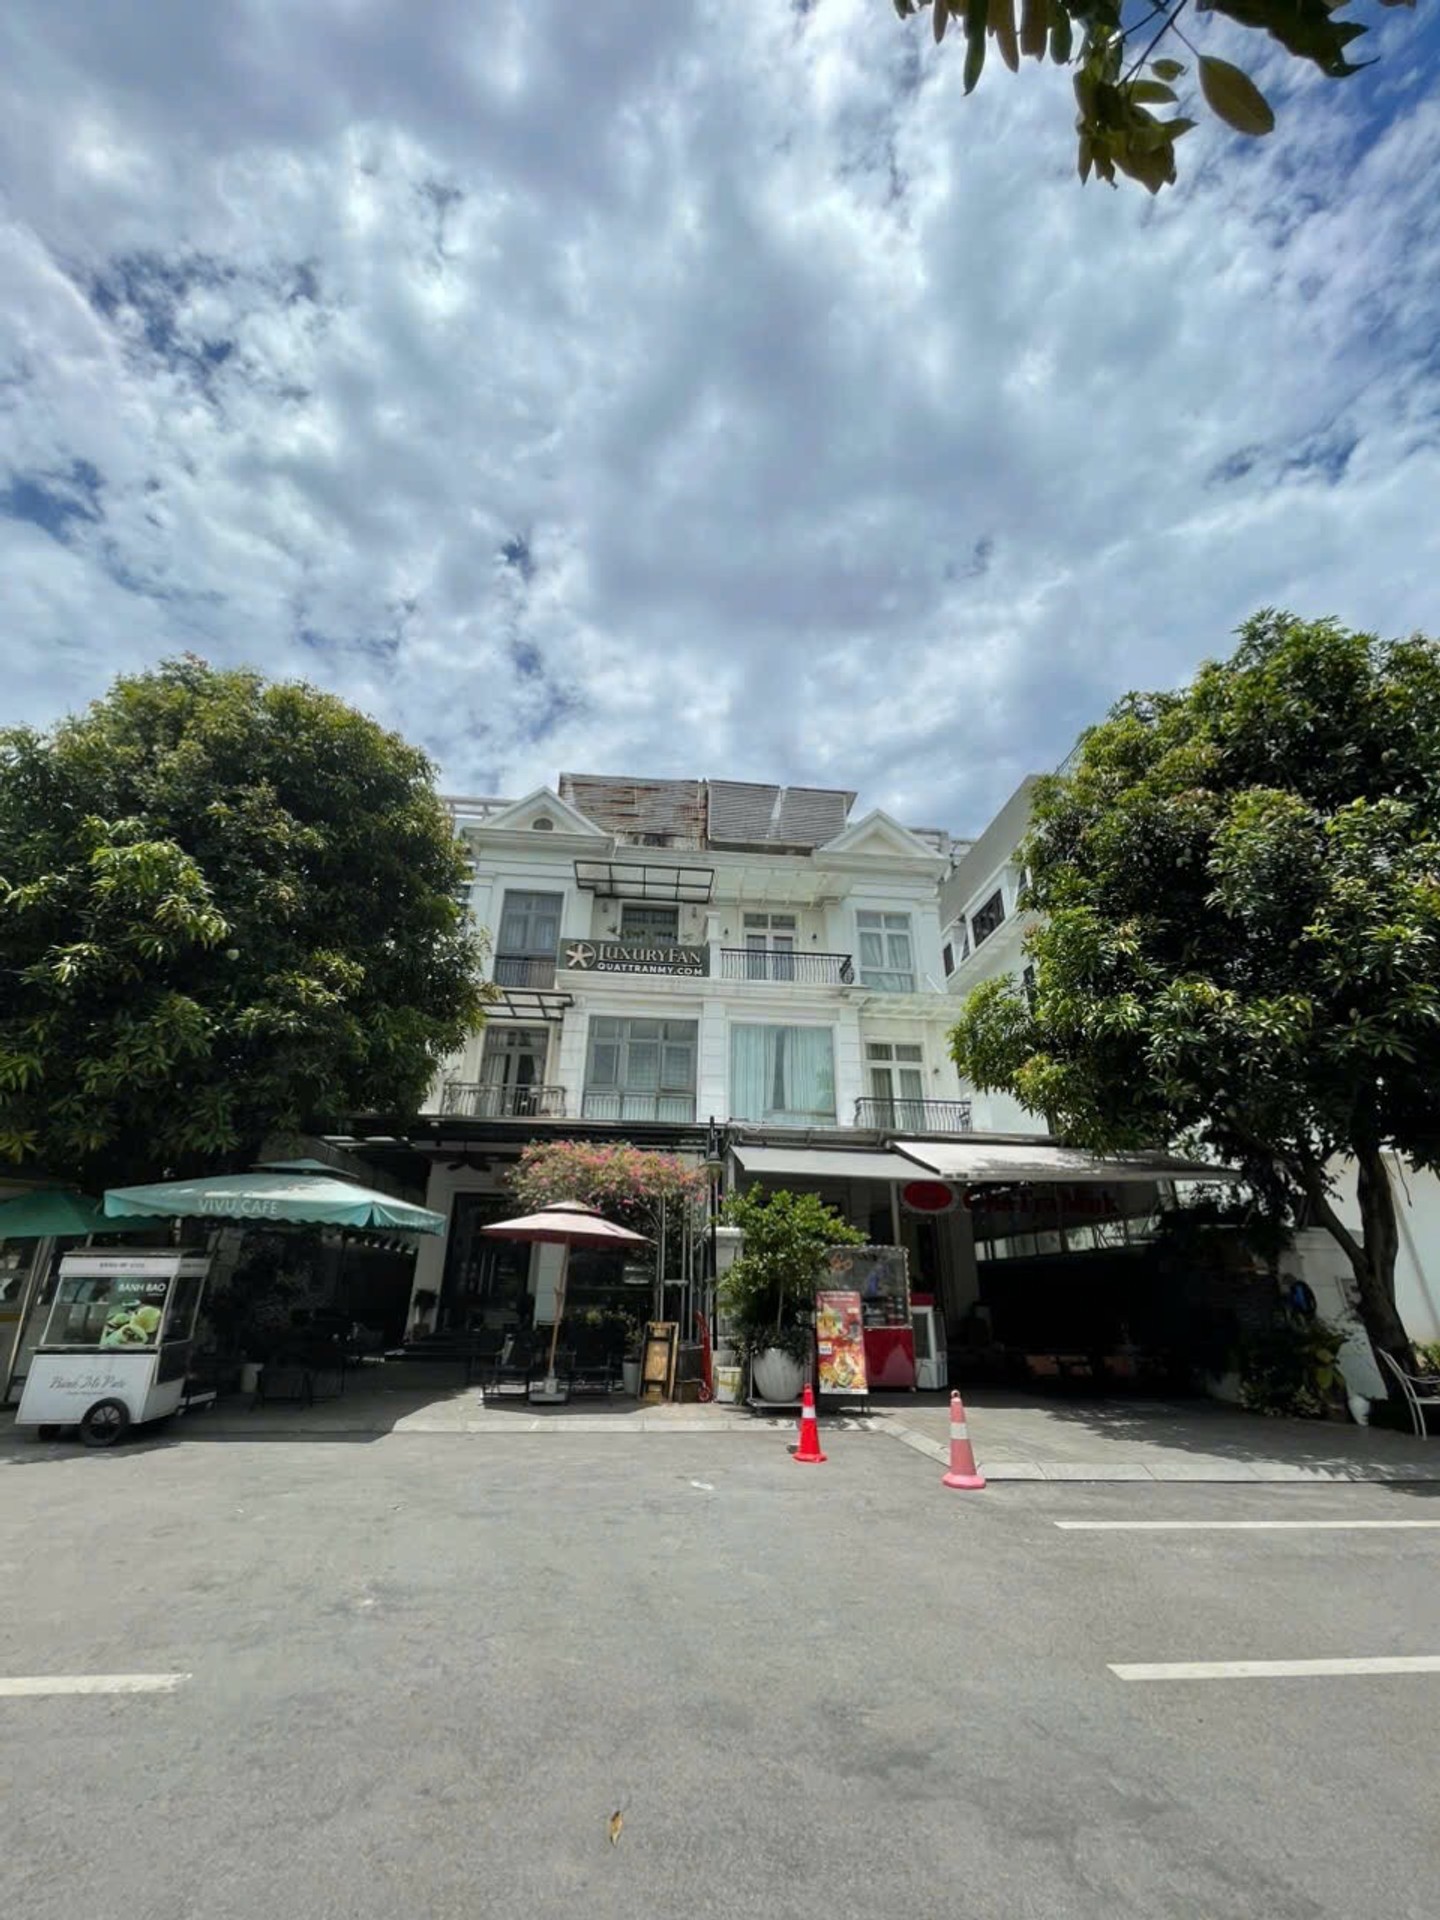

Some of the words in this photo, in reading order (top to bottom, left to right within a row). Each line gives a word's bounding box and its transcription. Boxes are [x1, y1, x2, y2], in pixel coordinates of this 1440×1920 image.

[597, 962, 703, 976] QUATTRANMY.COM
[198, 1199, 236, 1213] VIVU
[240, 1199, 278, 1214] CAFE
